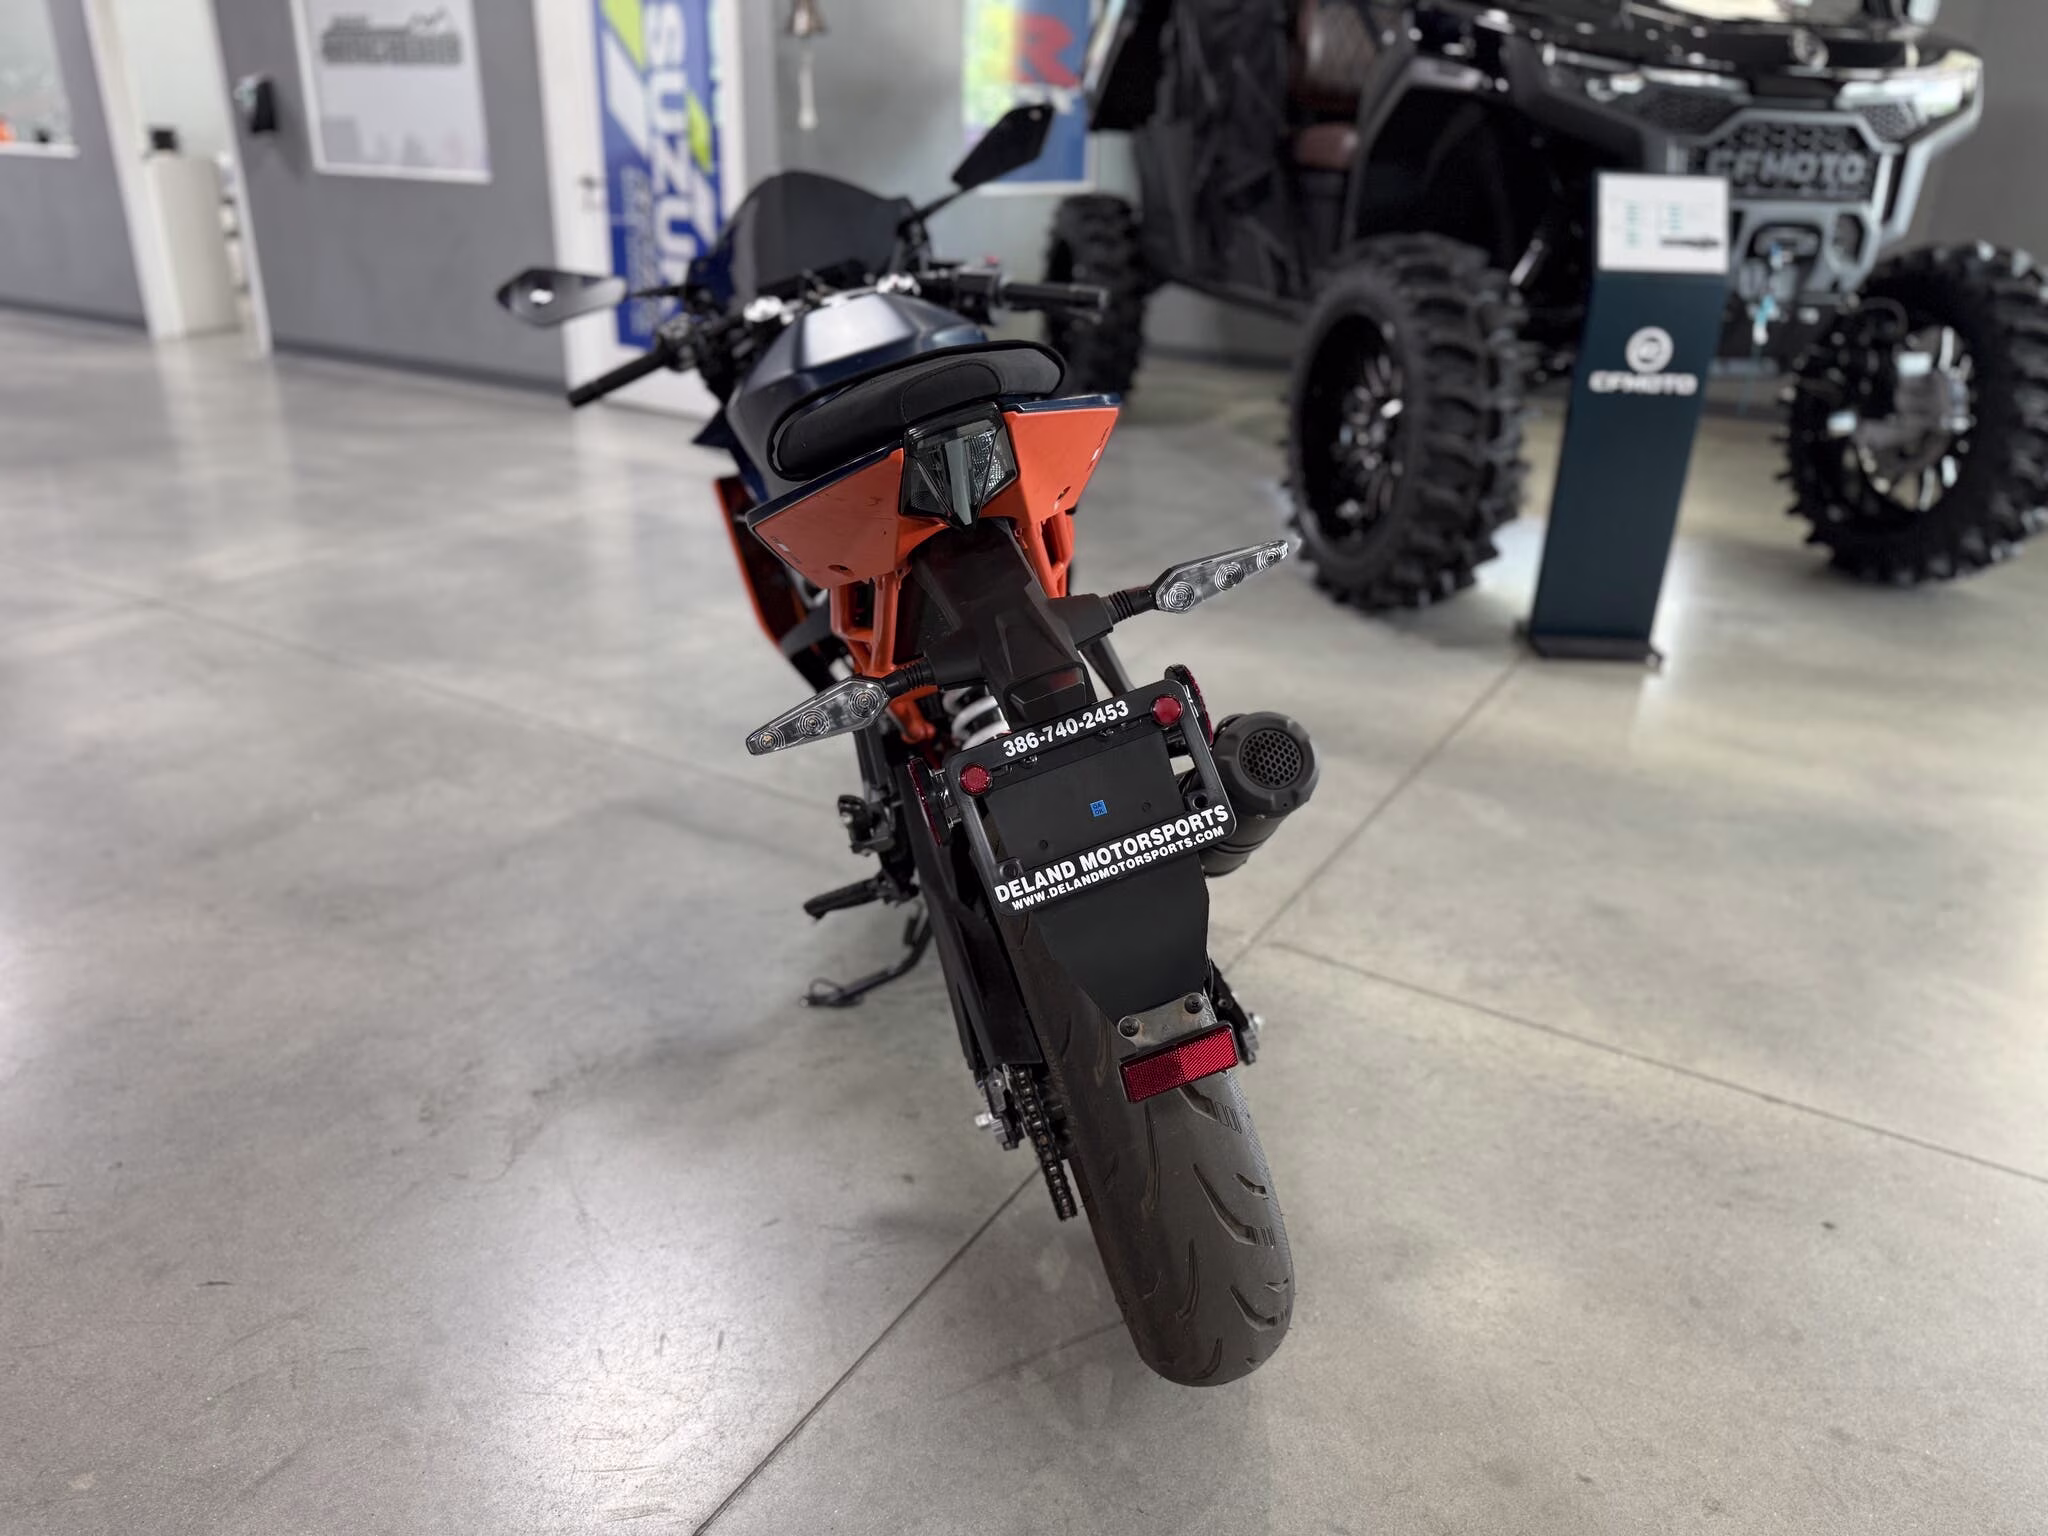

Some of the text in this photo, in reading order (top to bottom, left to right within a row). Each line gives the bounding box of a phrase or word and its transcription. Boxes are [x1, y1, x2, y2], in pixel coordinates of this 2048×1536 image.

[1705, 150, 1867, 185] CFMOTO
[1588, 370, 1698, 396] CFMOTO
[1003, 700, 1129, 757] 386-740-2453
[994, 805, 1229, 903] DELAND MOTORSPORTS
[1011, 826, 1224, 910] WWW.DELANDMOTORSPORTS.COM
